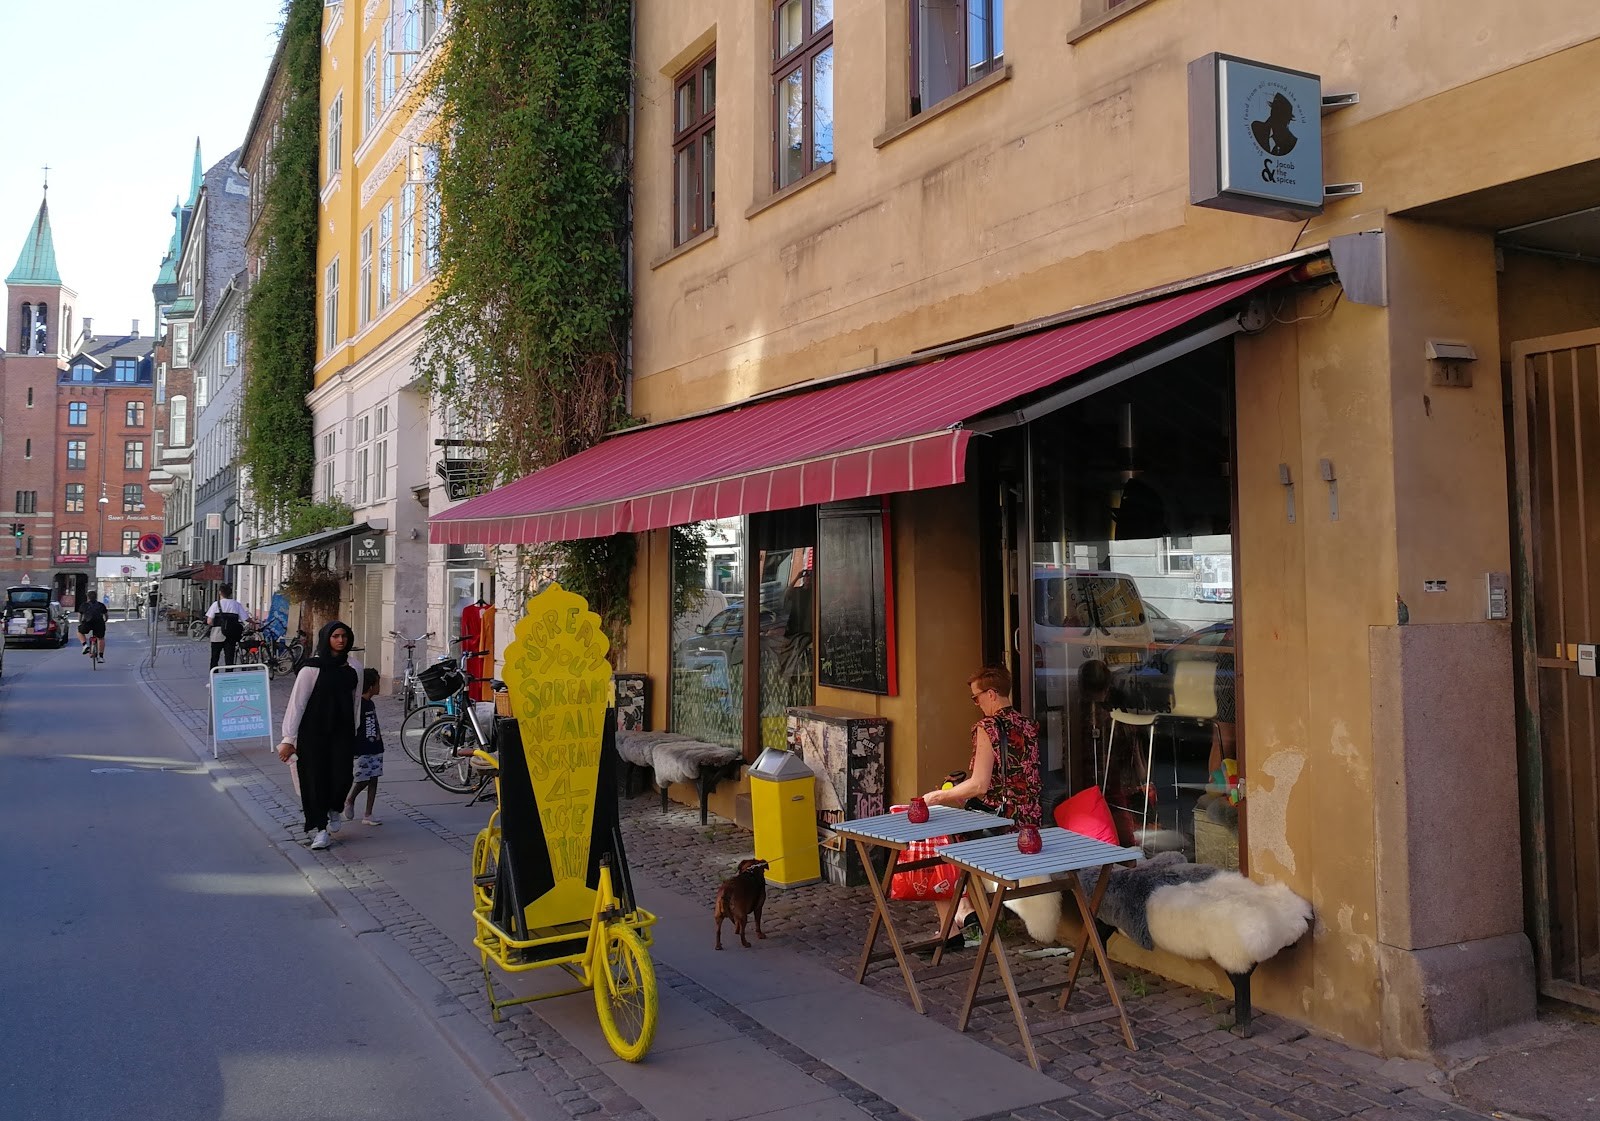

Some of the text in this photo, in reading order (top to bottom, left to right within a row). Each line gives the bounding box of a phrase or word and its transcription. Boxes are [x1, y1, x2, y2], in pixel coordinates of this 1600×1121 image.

[1276, 167, 1288, 177] the
[1276, 176, 1296, 185] spices
[522, 607, 604, 672] SCREAM
[539, 643, 587, 678] YOU
[519, 677, 607, 718] SCREAM
[521, 707, 599, 745] WE ALL
[529, 741, 601, 781] SCREAM
[544, 770, 591, 810] 4
[541, 804, 589, 835] ICE
